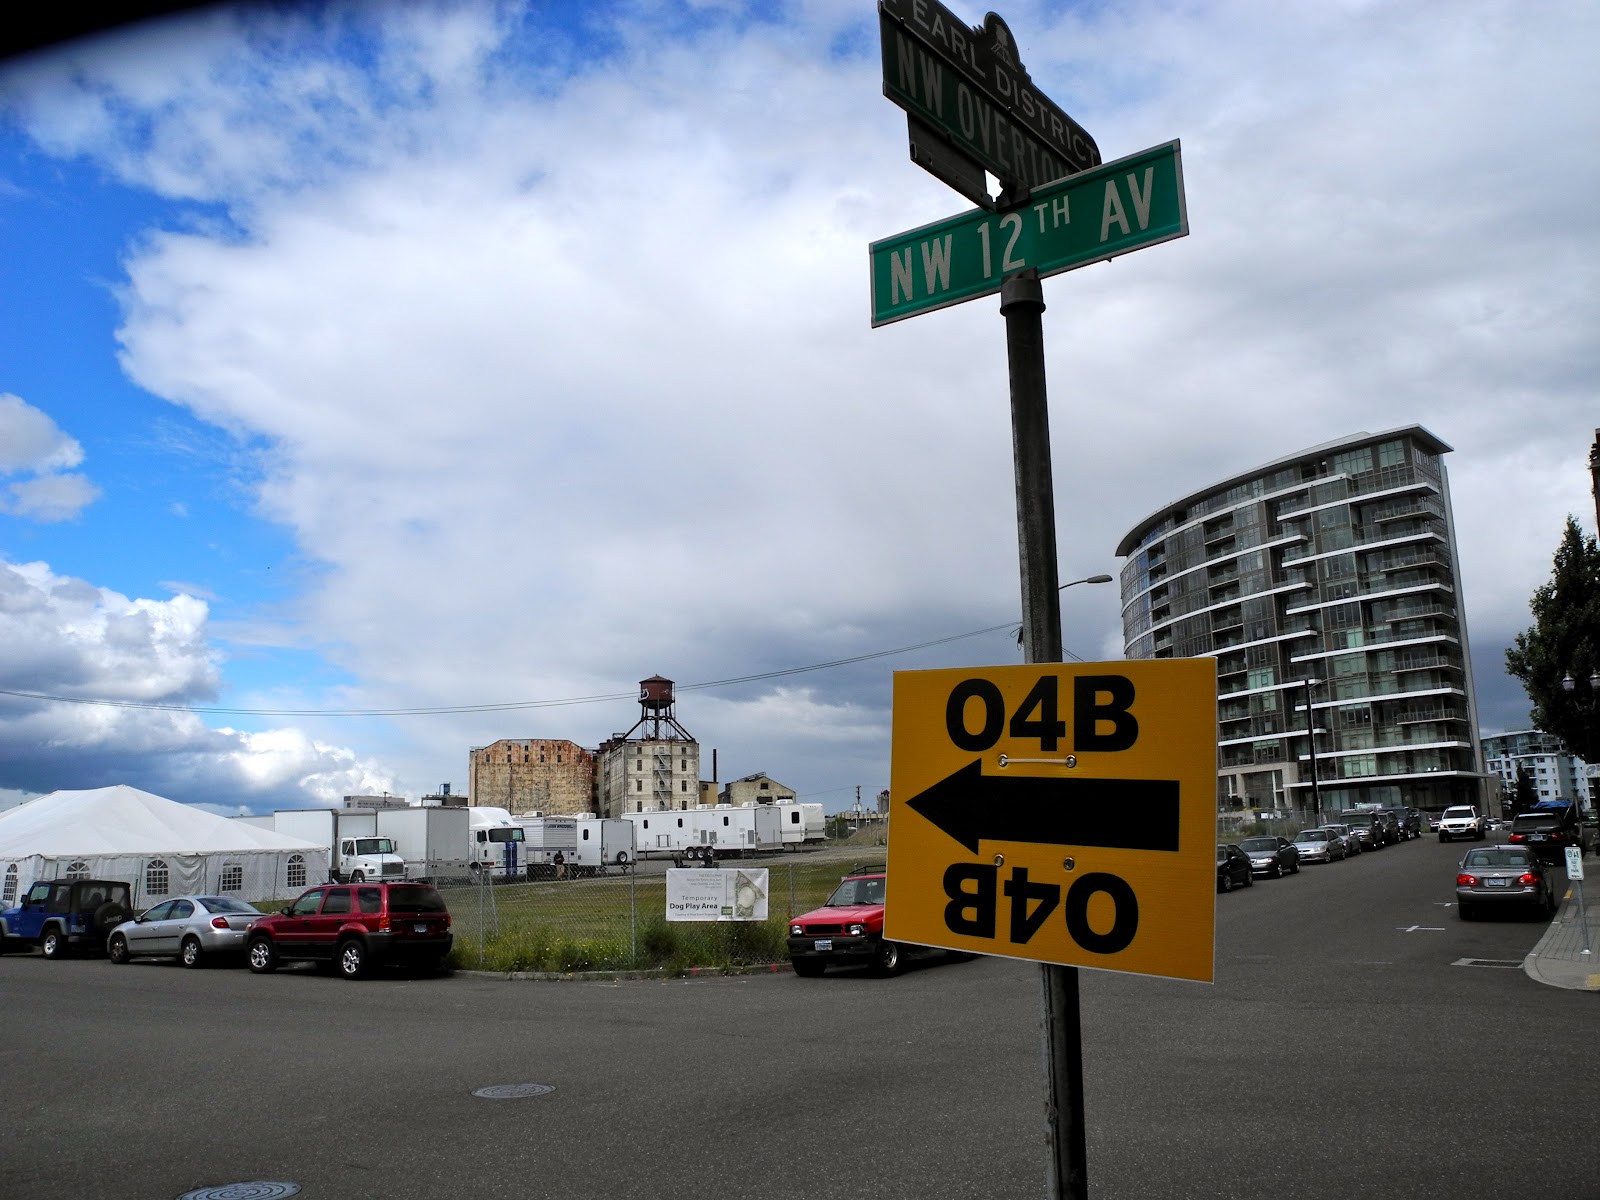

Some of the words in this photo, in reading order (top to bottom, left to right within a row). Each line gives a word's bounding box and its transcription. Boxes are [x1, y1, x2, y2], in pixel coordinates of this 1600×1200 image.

[893, 0, 986, 78] EARL
[995, 64, 1098, 167] DISTRICT
[896, 31, 943, 119] NW
[890, 233, 952, 305] NW
[1099, 166, 1155, 243] AV
[945, 674, 1139, 752] 04B
[104, 914, 123, 924] Jeep
[942, 862, 1139, 955] 04B
